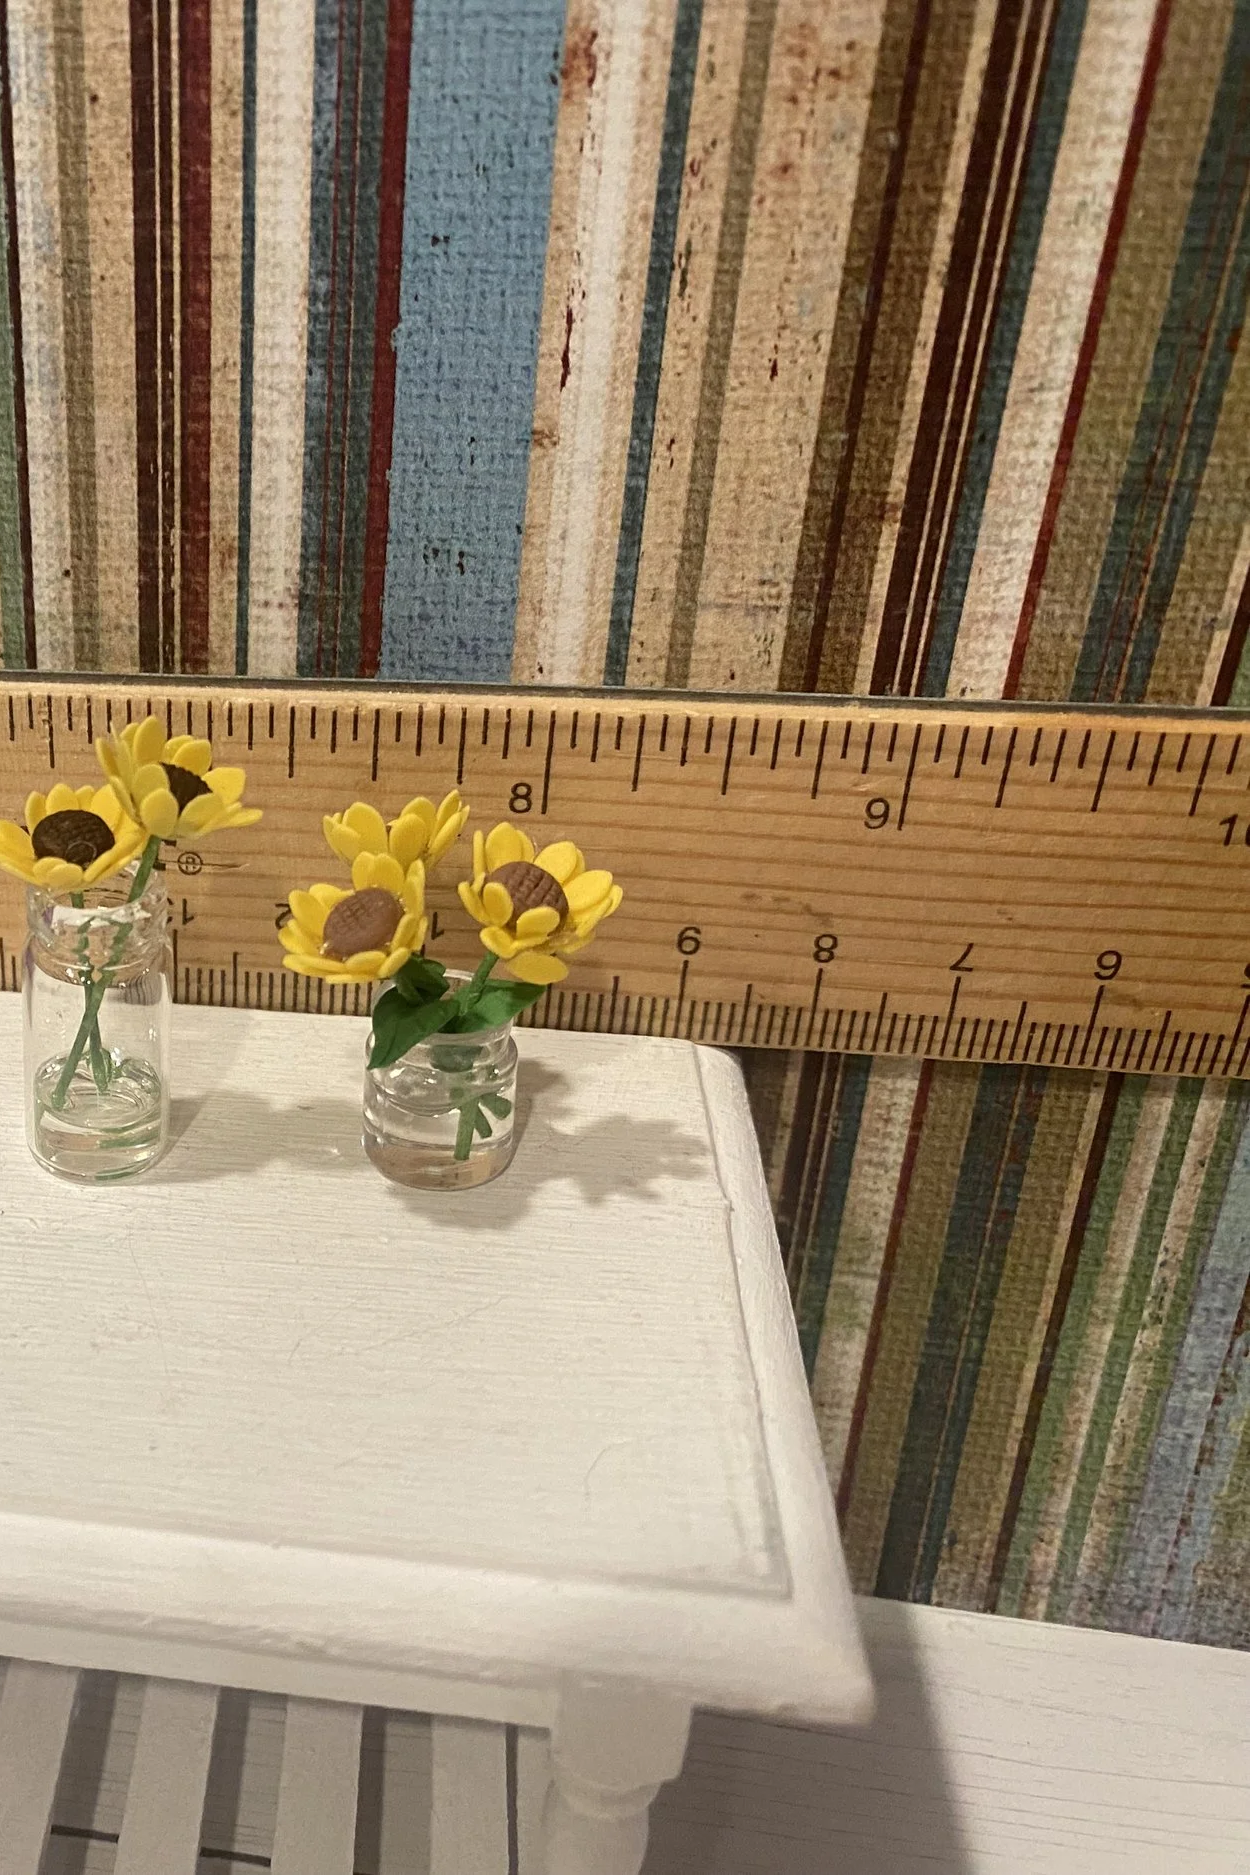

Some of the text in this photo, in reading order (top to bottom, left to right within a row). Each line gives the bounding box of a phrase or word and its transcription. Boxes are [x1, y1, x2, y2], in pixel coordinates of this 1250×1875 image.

[508, 782, 533, 814] 8
[864, 798, 890, 829] 9
[1219, 814, 1250, 847] 1
[813, 934, 838, 963] 8
[950, 943, 974, 972] 7
